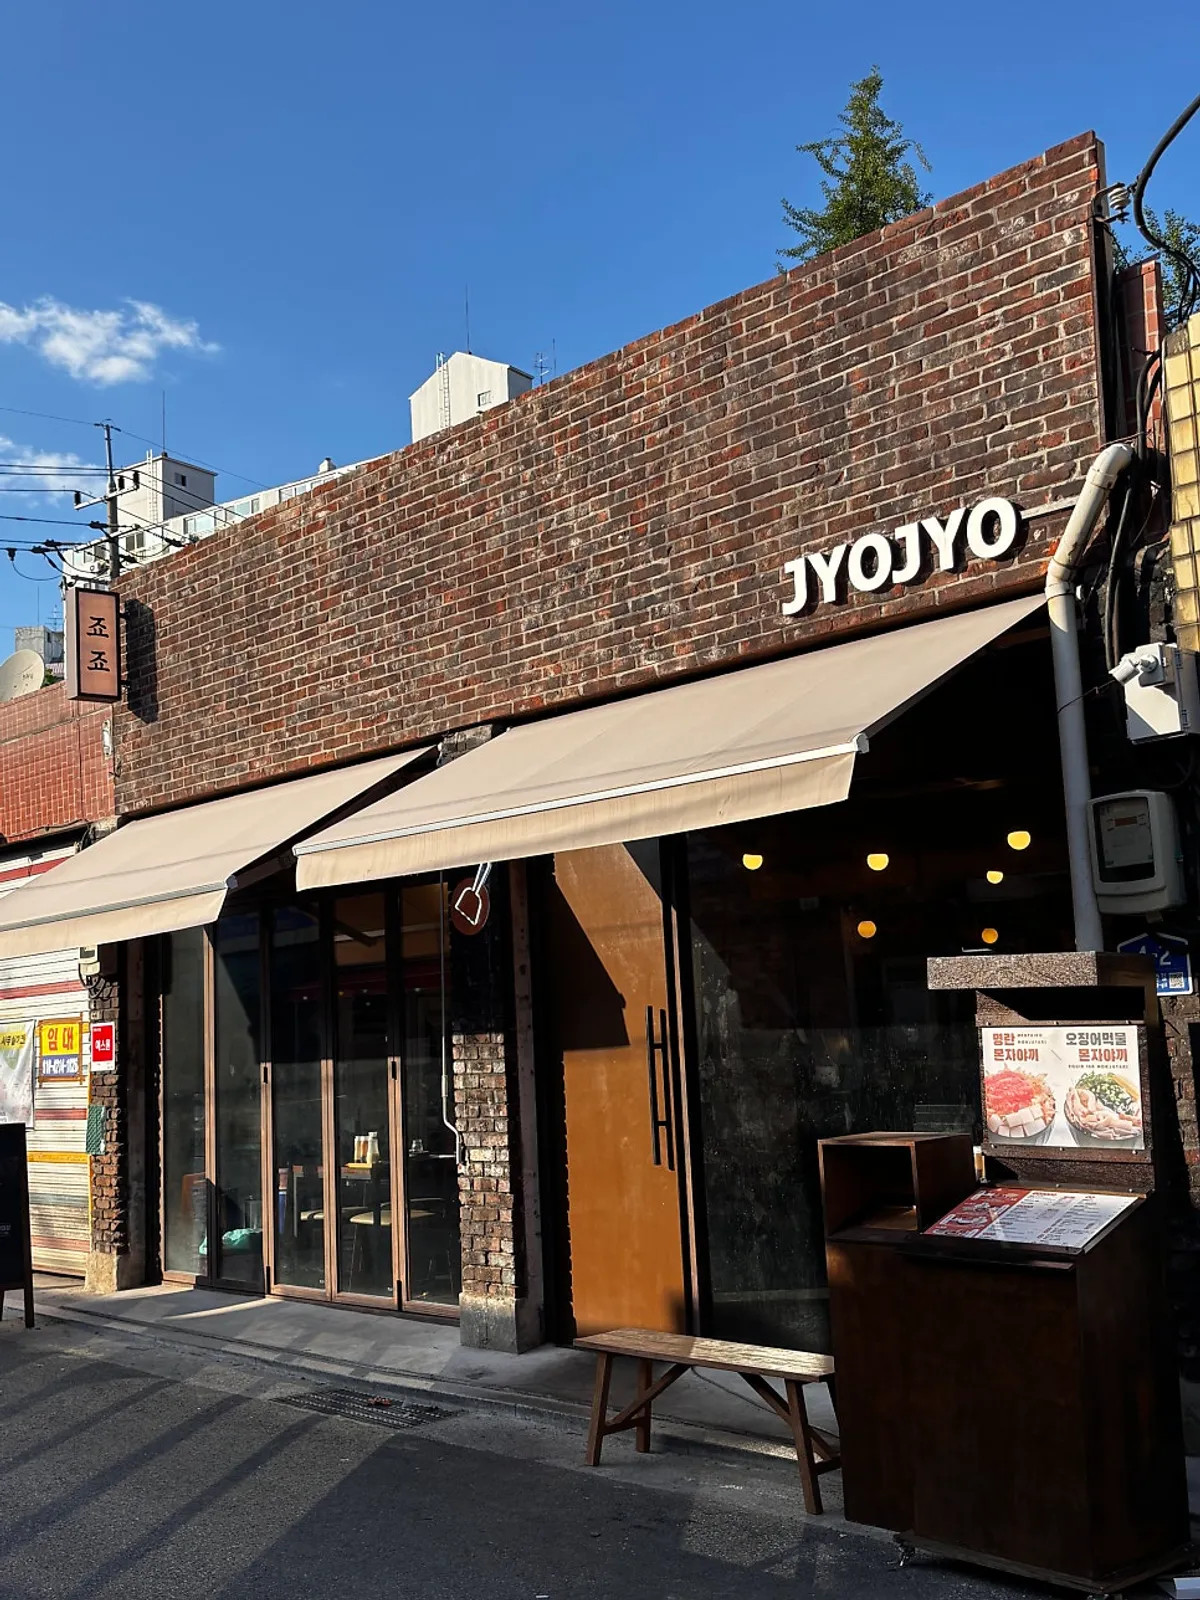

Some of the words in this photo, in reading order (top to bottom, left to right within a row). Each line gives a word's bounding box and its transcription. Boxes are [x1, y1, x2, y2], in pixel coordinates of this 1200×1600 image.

[782, 497, 1016, 615] JYOJYO
[86, 616, 111, 671] 죠죠
[992, 1033, 1015, 1046] 명란
[1066, 1032, 1127, 1046] 오징어먹물
[993, 1048, 1039, 1062] 몬자야끼
[1078, 1048, 1128, 1062] 몬자야끼
